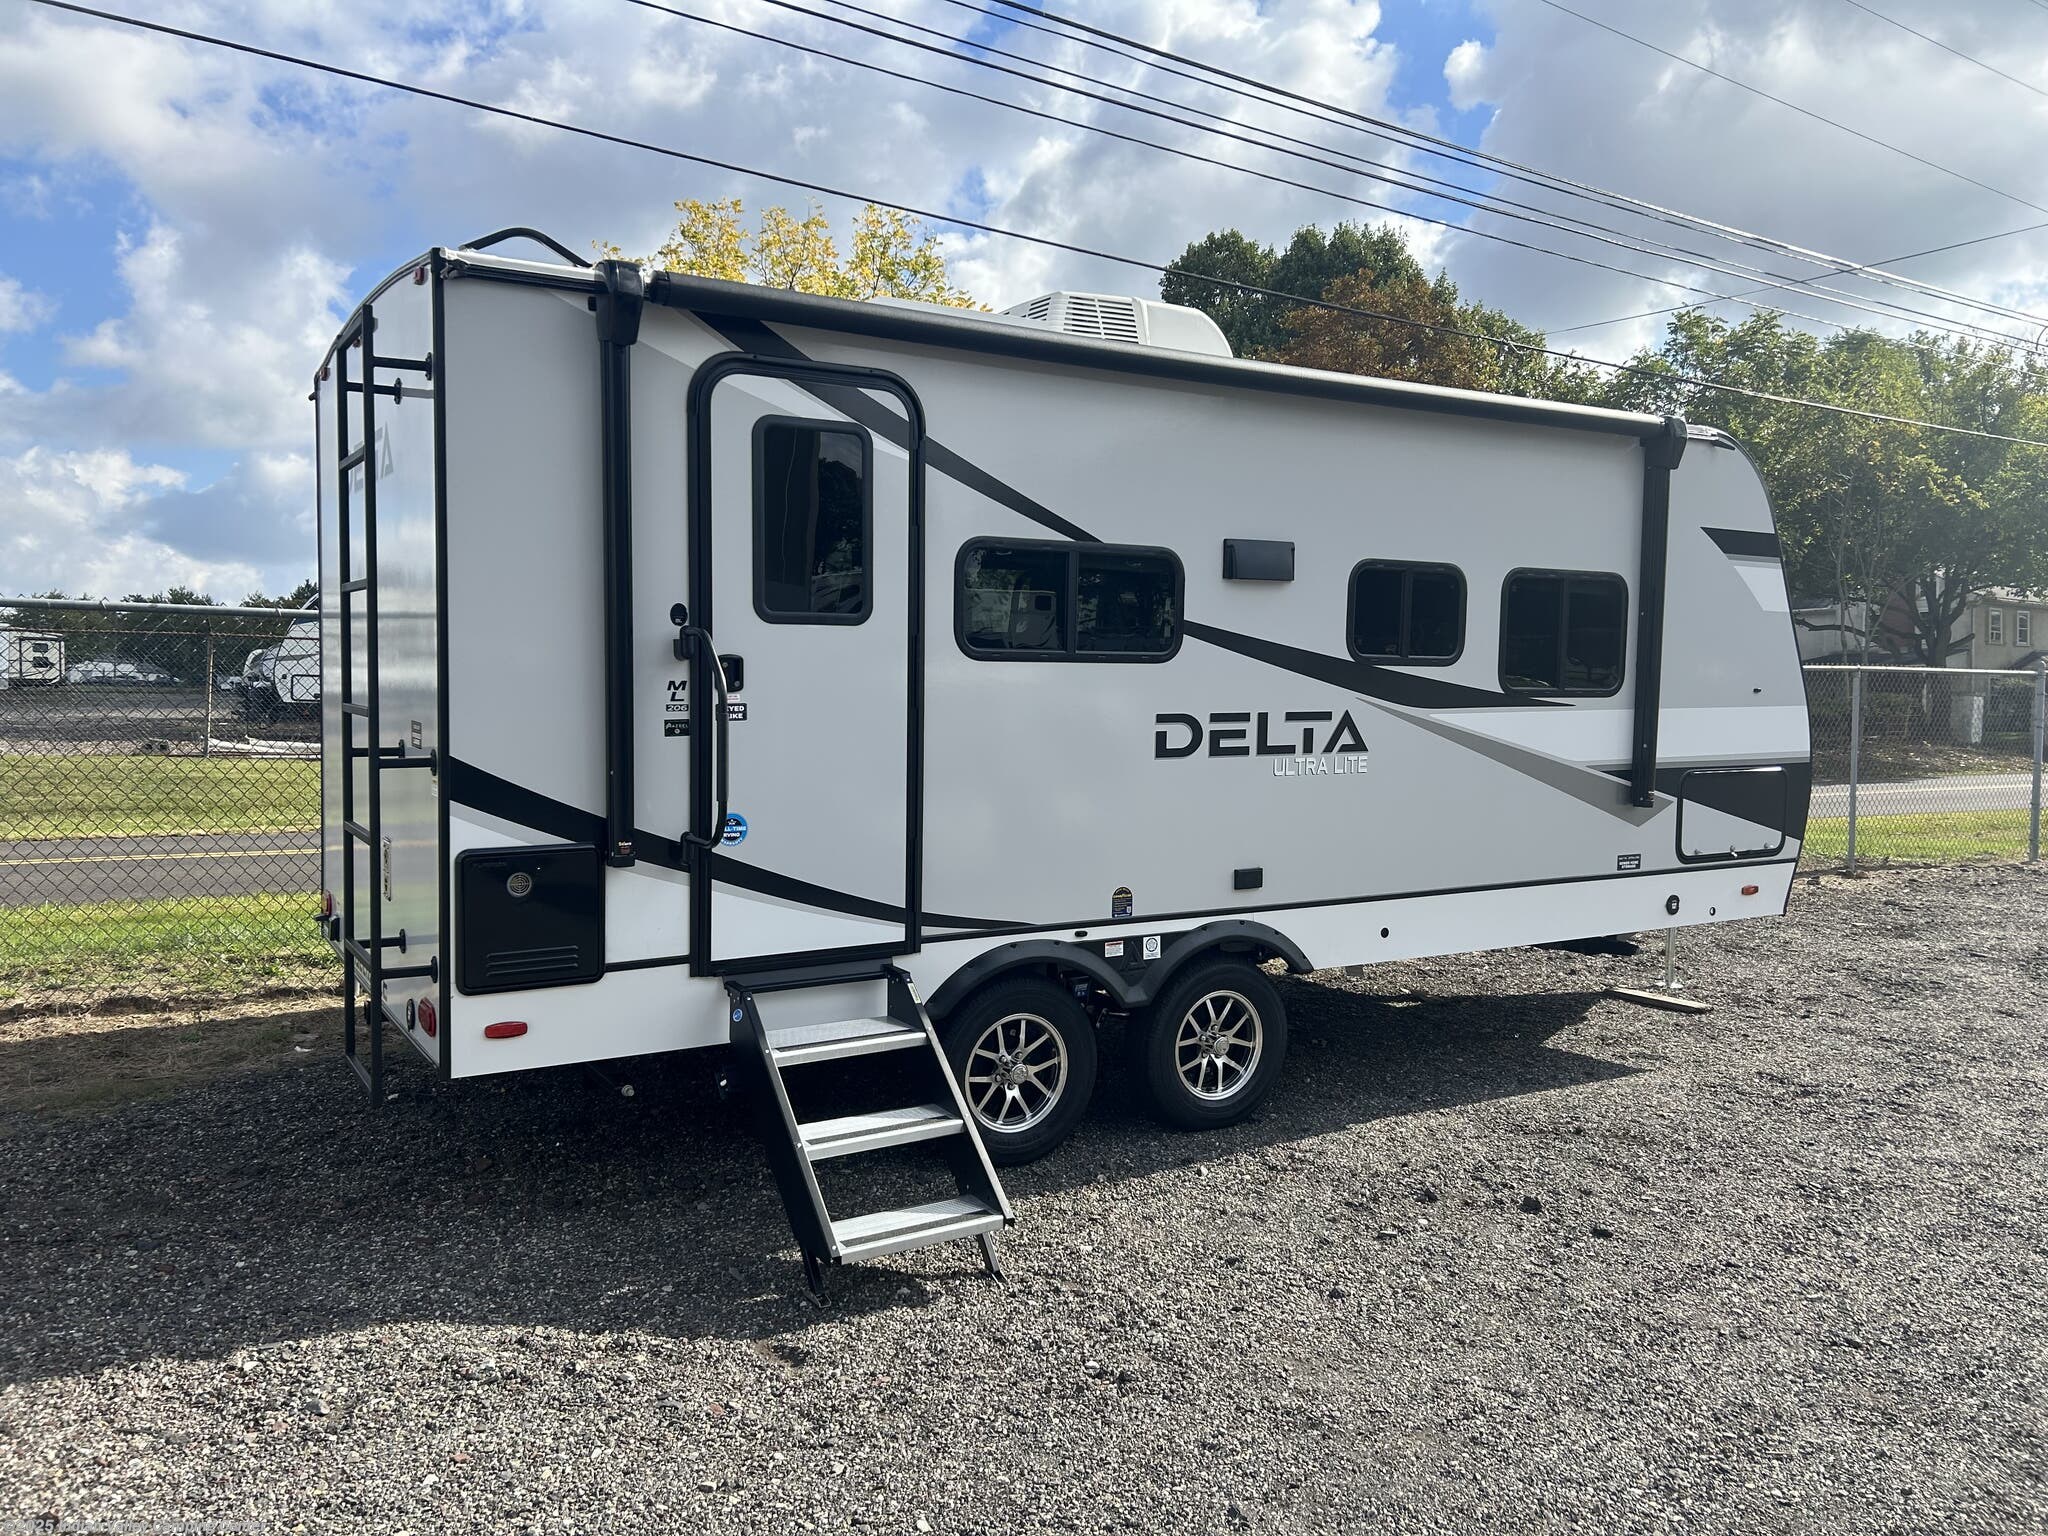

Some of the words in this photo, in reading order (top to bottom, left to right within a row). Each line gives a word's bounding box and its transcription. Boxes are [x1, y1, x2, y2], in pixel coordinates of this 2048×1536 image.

[667, 680, 688, 691] M
[670, 691, 685, 702] L
[1154, 709, 1369, 760] DELTA
[1273, 756, 1328, 777] ULTRA
[1333, 754, 1369, 775] LITE
